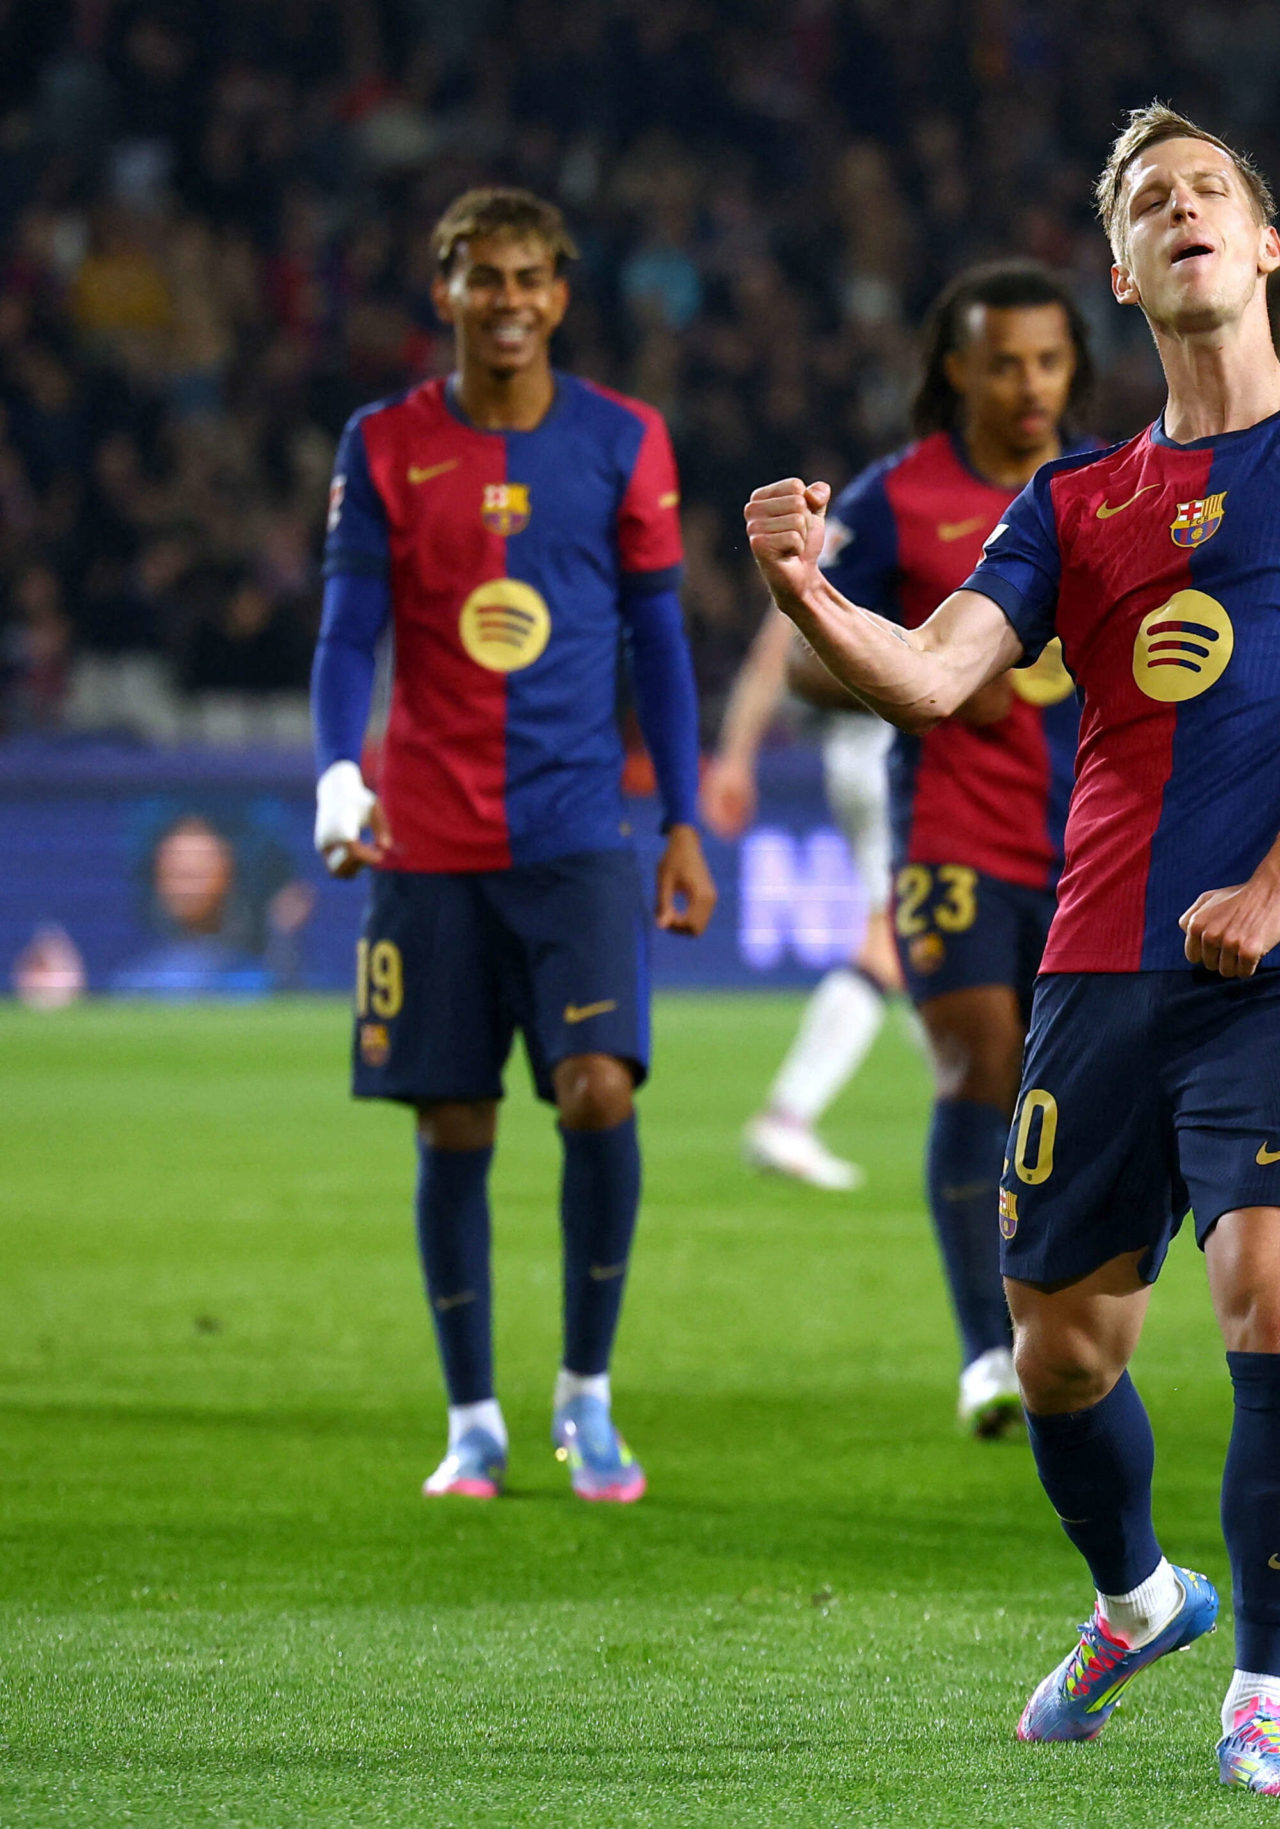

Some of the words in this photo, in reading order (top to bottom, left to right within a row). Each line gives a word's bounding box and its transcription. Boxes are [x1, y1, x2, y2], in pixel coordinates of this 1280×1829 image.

[898, 864, 977, 934] 23
[357, 938, 403, 1019] 19
[1003, 1088, 1058, 1185] 0
